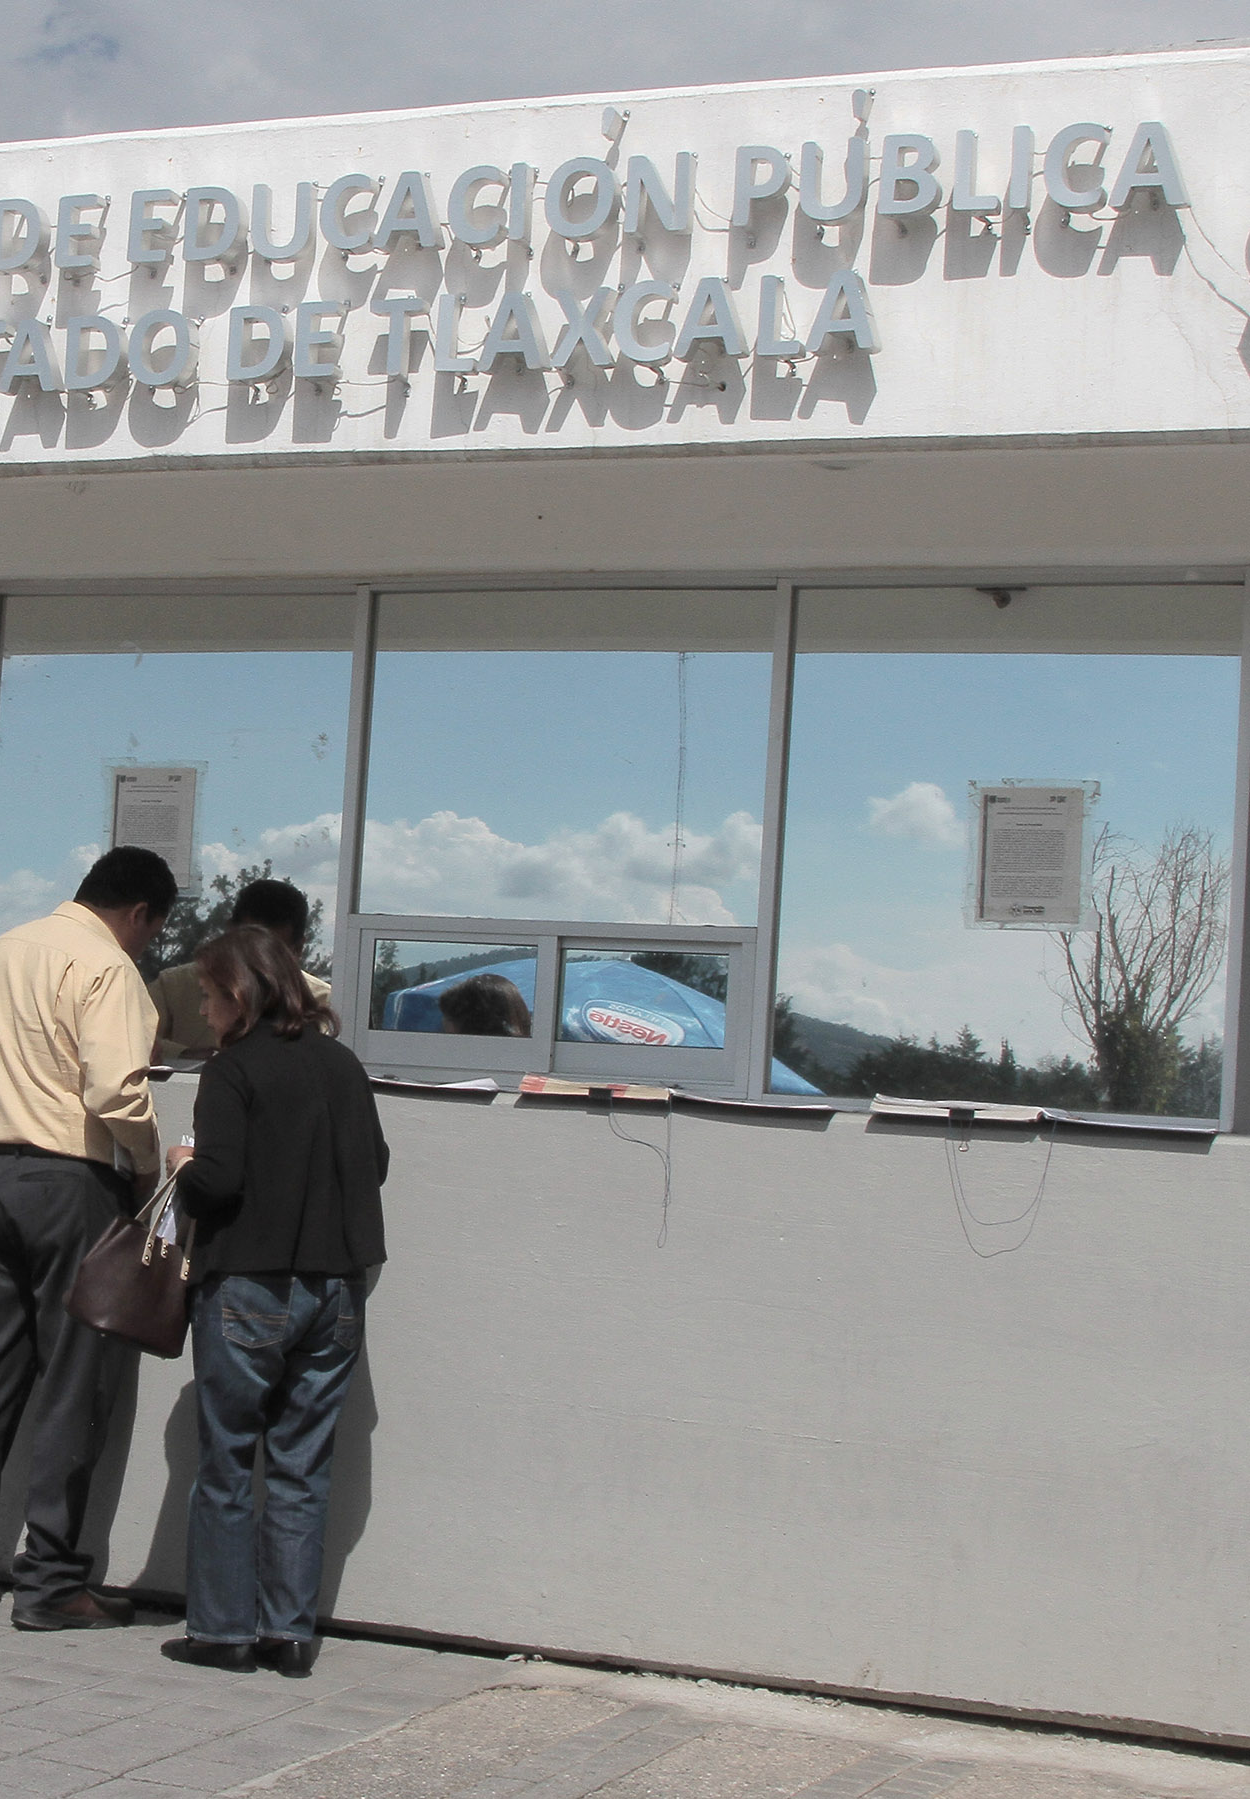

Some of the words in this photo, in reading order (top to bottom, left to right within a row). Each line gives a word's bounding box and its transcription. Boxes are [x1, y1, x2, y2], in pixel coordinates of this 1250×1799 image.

[127, 106, 694, 265] EDUCACIÓN
[732, 88, 1190, 228] PÚBLICA
[227, 301, 347, 382] DE
[370, 268, 882, 377] TLAXCALA
